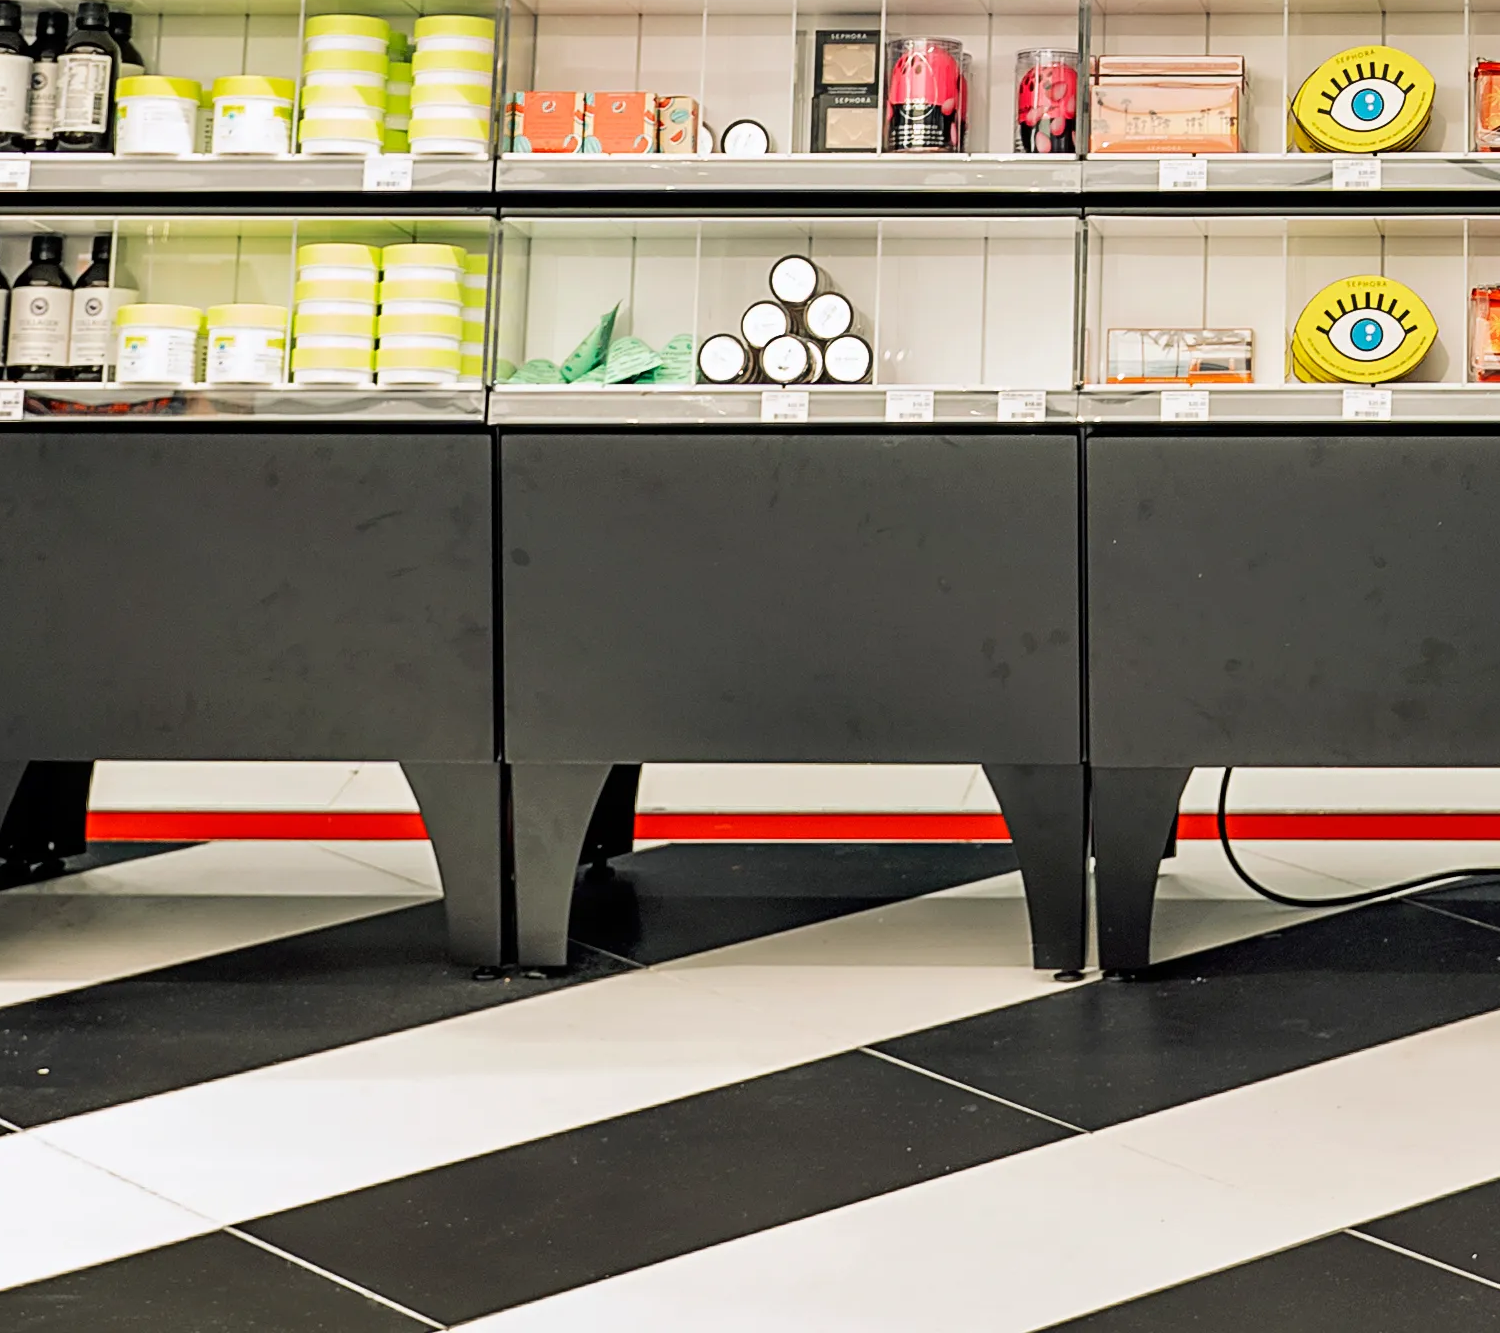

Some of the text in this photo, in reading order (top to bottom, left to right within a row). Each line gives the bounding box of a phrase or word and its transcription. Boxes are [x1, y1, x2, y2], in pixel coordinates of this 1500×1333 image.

[831, 32, 868, 40] SEPHORA
[1335, 48, 1377, 65] SEPHORA
[834, 96, 871, 105] SEPHORA
[1346, 280, 1388, 288] SEPHORA
